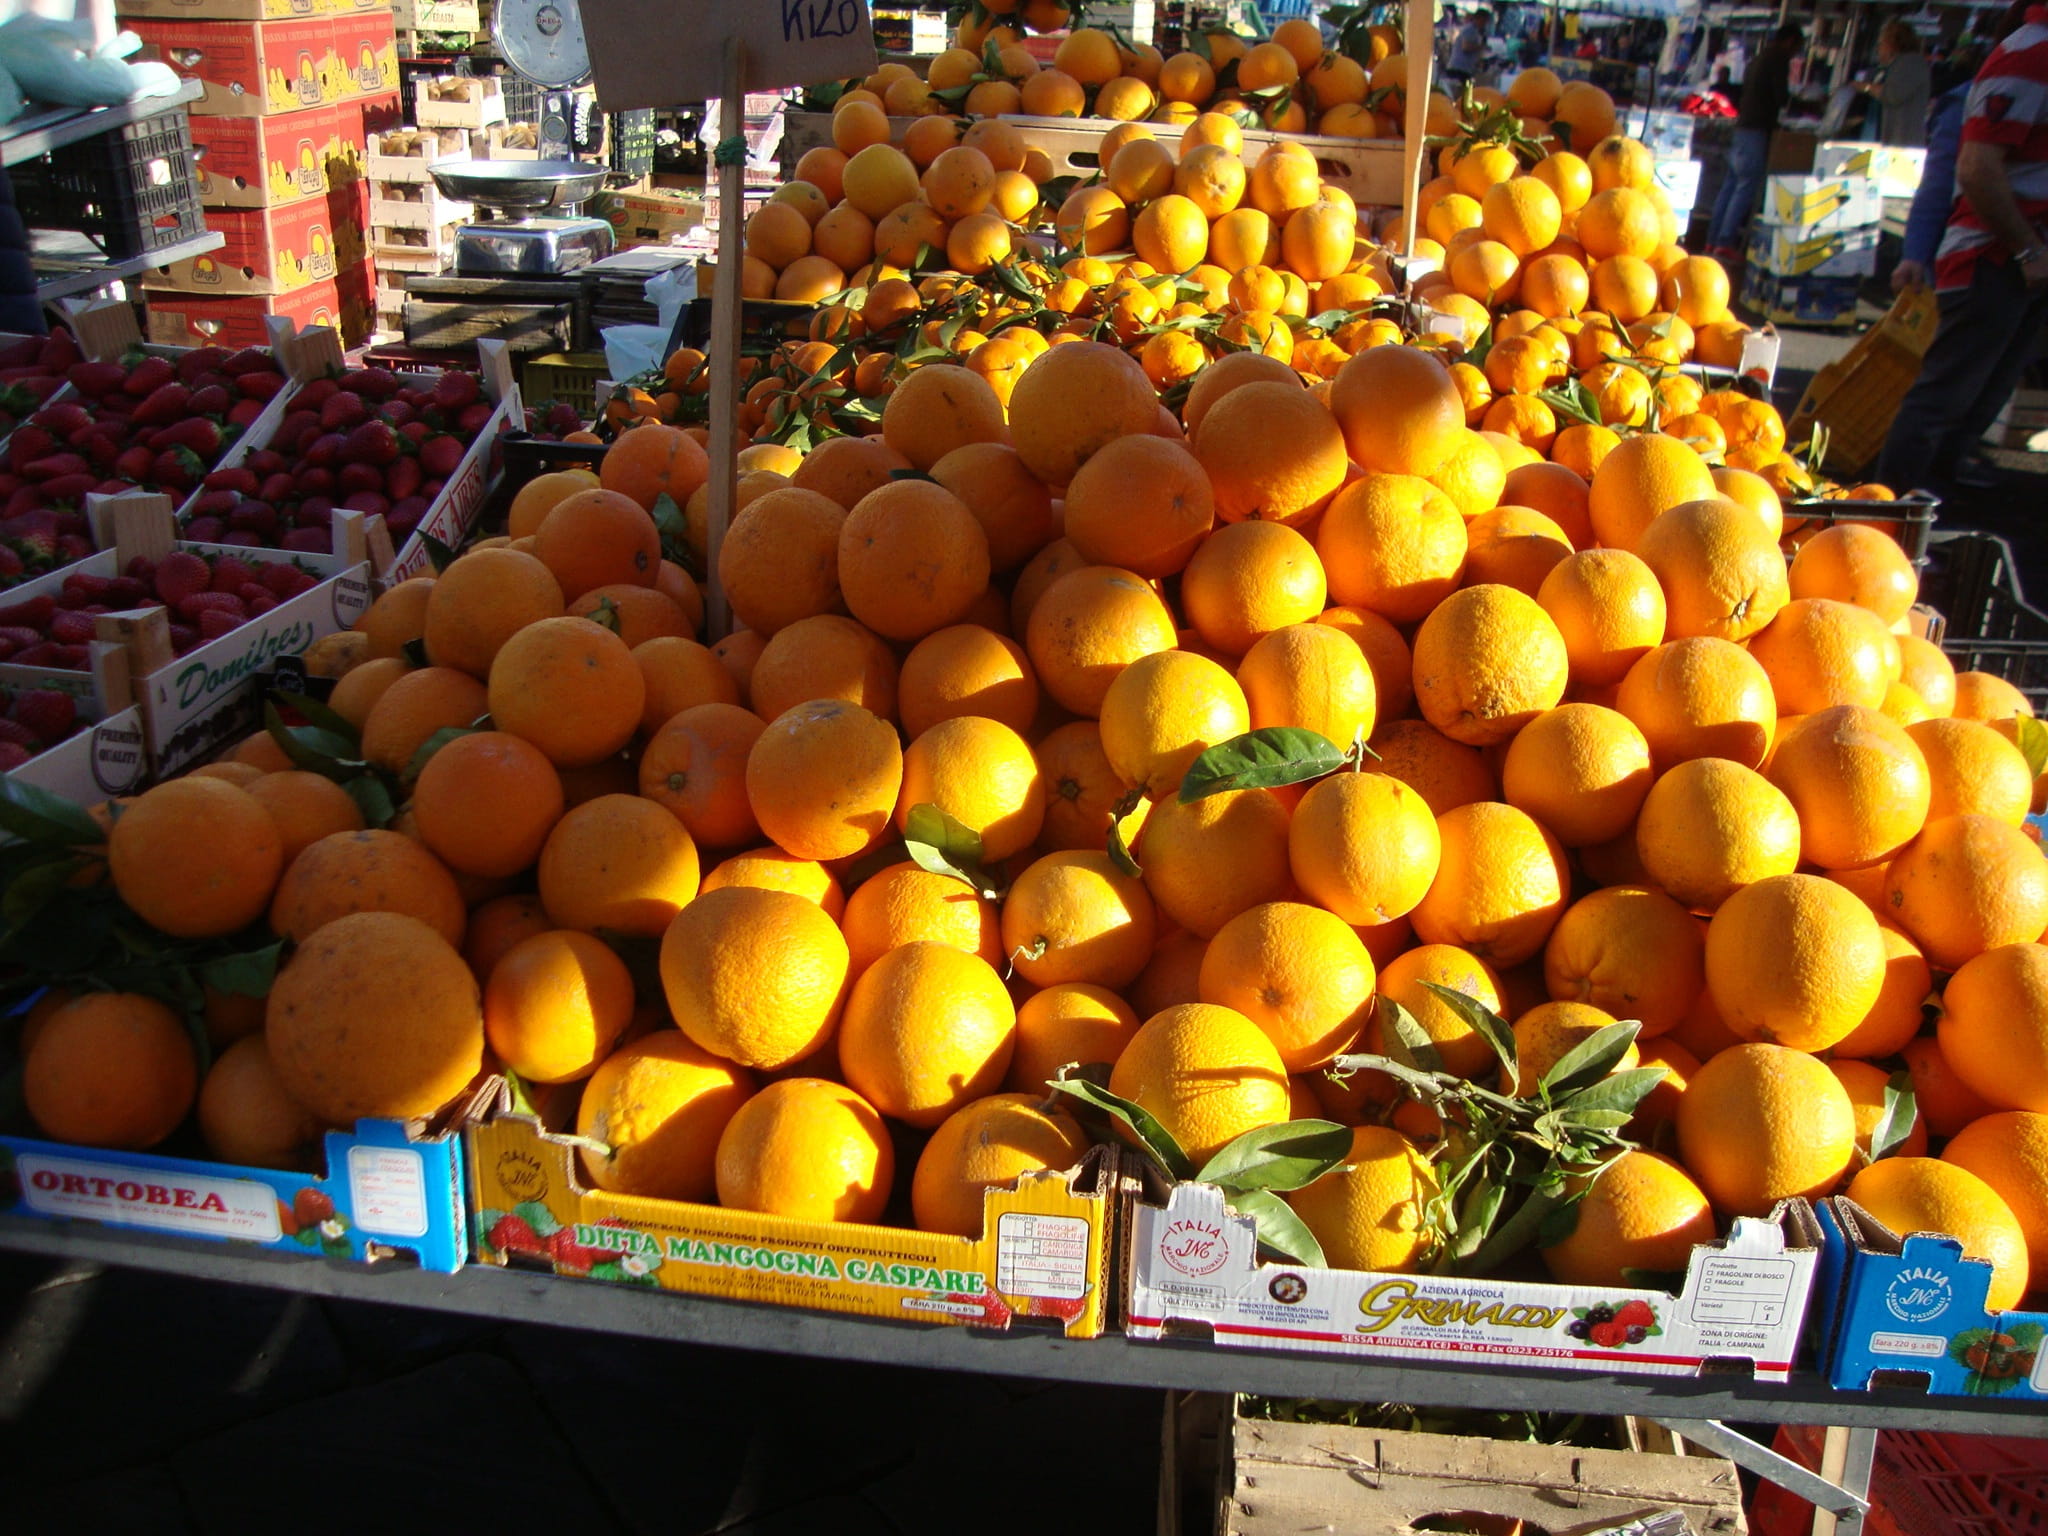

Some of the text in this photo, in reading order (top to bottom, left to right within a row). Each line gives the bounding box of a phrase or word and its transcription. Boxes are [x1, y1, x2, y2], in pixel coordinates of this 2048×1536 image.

[31, 1169, 230, 1214] ORTOBEA
[1168, 1219, 1221, 1239] ITALIA
[693, 1227, 757, 1243] INGROSSO
[760, 1236, 824, 1249] PRODOTTI
[826, 1244, 938, 1263] ORTOFRUTTICOLI
[574, 1223, 985, 1295] DITTA MANGOGNA GASPARE
[1716, 1270, 1753, 1279] FRAGOLINE
[1896, 1267, 1949, 1288] ITALIA
[819, 1290, 875, 1305] MARSALA
[1421, 1285, 1504, 1299] AZIENDA AGRICOLA
[1355, 1278, 1568, 1333] GRIMALDI
[1409, 1326, 1447, 1334] GRIMALDI
[1700, 1329, 1722, 1338] ZONA
[1341, 1333, 1374, 1344] SESSA
[1375, 1336, 1430, 1348] AURUNCA
[1430, 1338, 1451, 1350] (CE)
[1459, 1342, 1476, 1352] Tel.
[1487, 1343, 1504, 1353] Fax
[1505, 1345, 1574, 1358] 0823.735176
[1698, 1339, 1721, 1347] ITALIA
[1726, 1340, 1765, 1349] CAMPANIA
